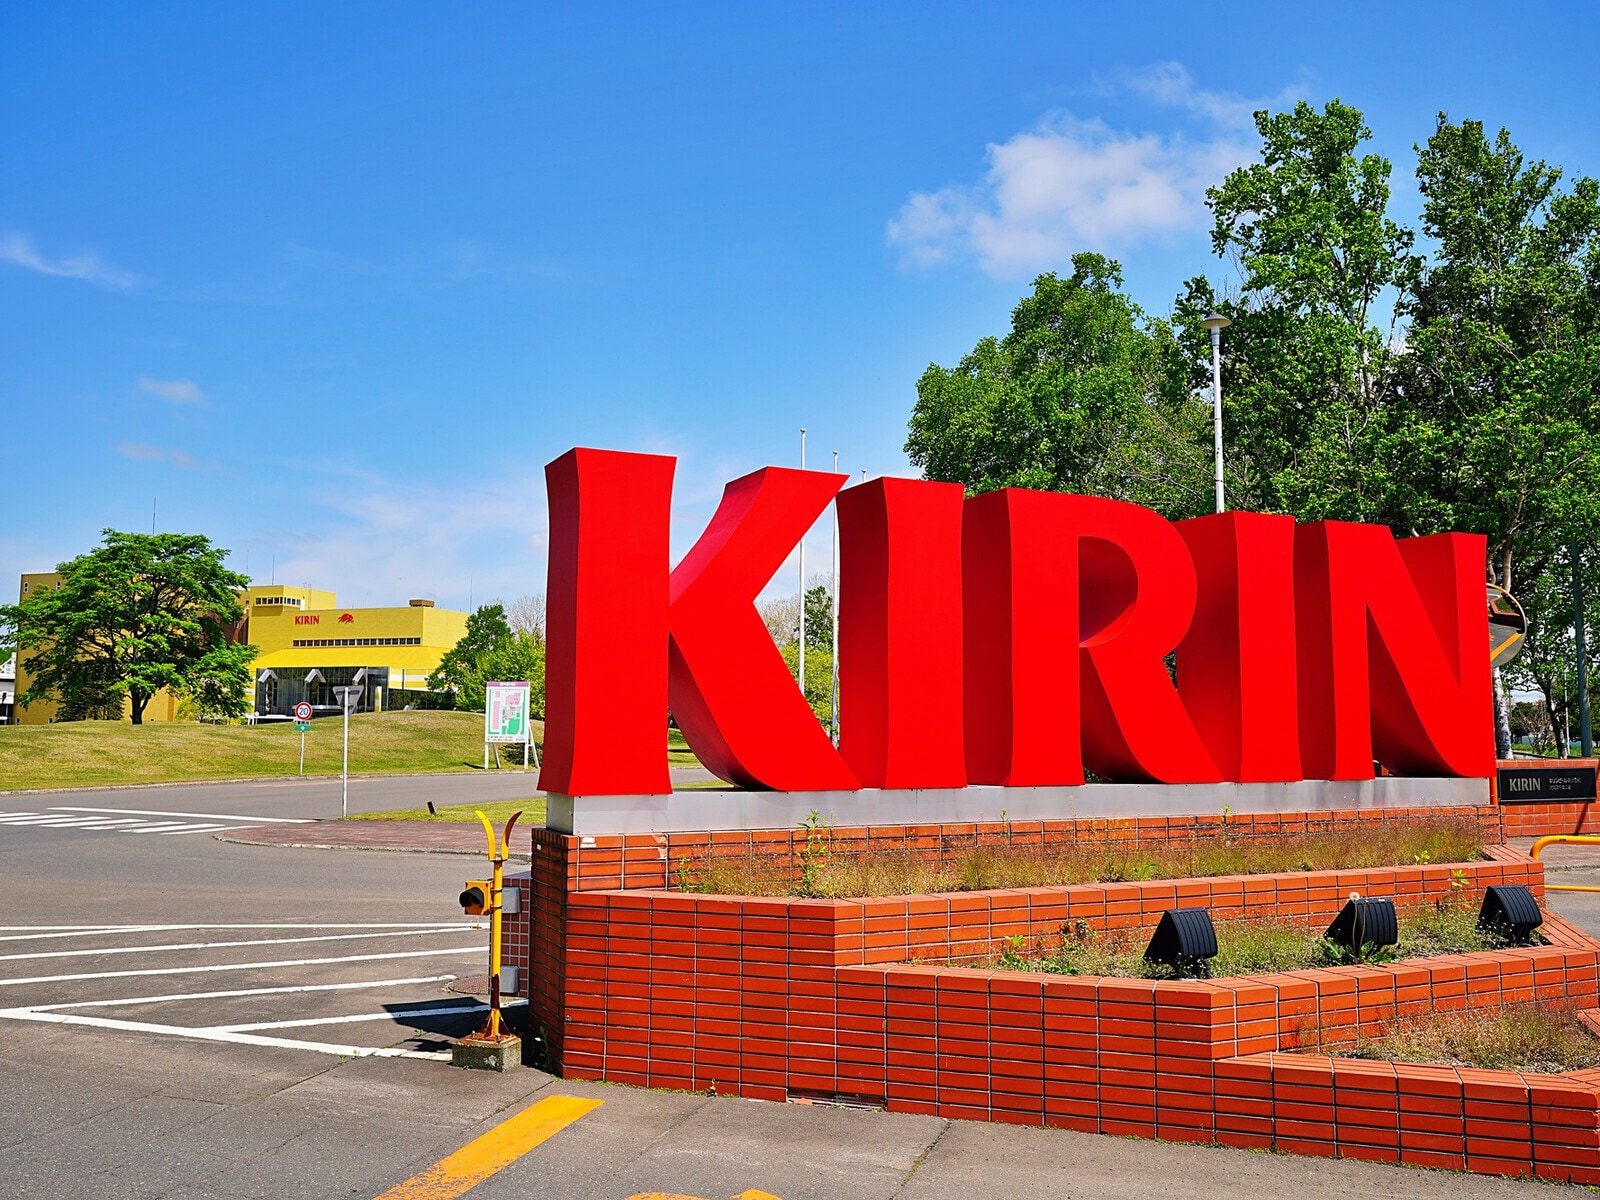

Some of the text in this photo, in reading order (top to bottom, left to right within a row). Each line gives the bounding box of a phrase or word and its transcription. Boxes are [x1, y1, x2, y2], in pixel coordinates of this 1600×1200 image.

[294, 615, 320, 625] KIRIN
[538, 446, 1491, 796] KIRIN
[299, 707, 308, 716] 20
[1509, 777, 1541, 792] KIRIN
